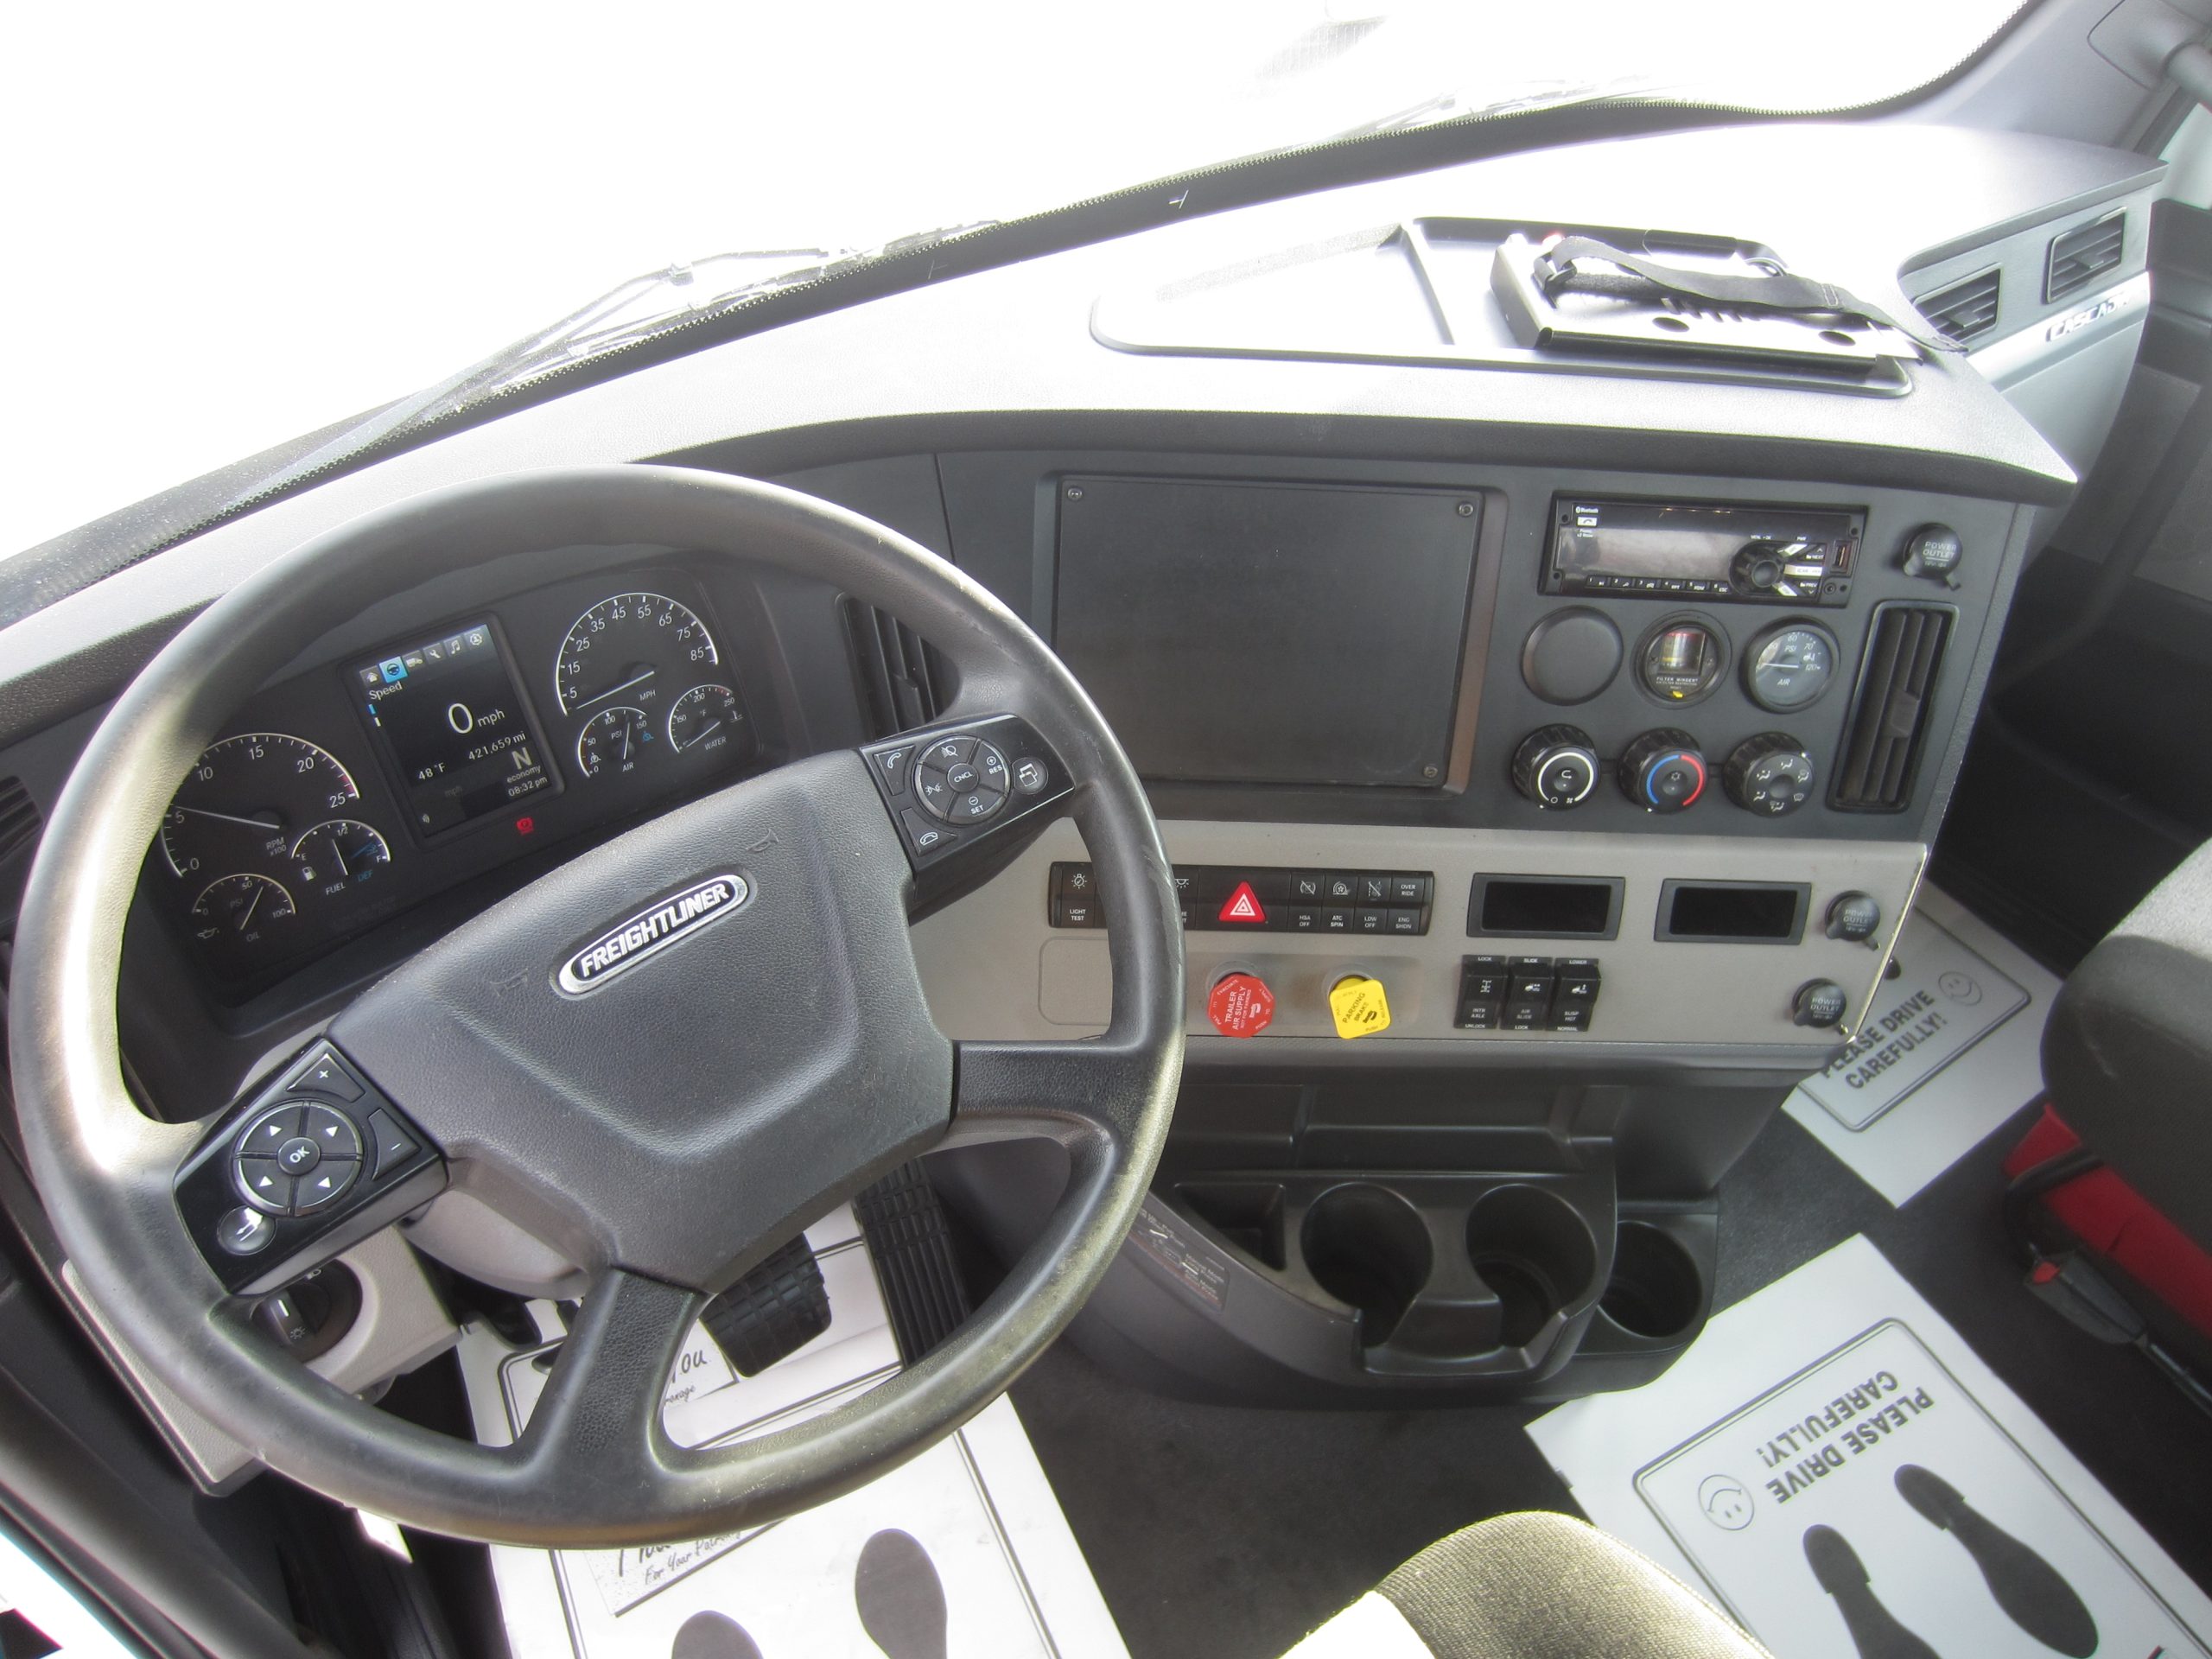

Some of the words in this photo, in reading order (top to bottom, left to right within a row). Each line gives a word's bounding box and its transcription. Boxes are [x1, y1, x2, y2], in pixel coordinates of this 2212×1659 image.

[1925, 542, 1956, 550] POWER
[1923, 550, 1955, 558] OUTLET
[612, 607, 626, 620] 45
[637, 605, 652, 620] 55
[590, 619, 606, 632] 35
[658, 613, 672, 627] 65
[677, 627, 691, 642] 75
[575, 637, 590, 652] 25
[690, 646, 704, 662] 85
[568, 661, 581, 675] 15
[368, 681, 403, 700] Speed
[569, 687, 578, 699] 5
[639, 690, 657, 702] MPH
[693, 693, 705, 703] 200
[723, 697, 734, 707] 250
[448, 702, 474, 734] 0
[477, 709, 505, 728] mph
[604, 715, 616, 725] 100
[677, 715, 687, 723] 150
[636, 720, 647, 730] 150
[513, 730, 526, 743] mi
[611, 731, 622, 740] PSI
[704, 736, 727, 751] WATER
[249, 745, 264, 760] 15
[512, 747, 533, 770] N
[297, 757, 315, 773] 20
[622, 762, 634, 772] AIR
[988, 765, 1003, 775] RES
[198, 766, 213, 781] 10
[507, 764, 542, 784] economy
[953, 772, 973, 783] CNCL
[508, 781, 535, 797] 08:32
[535, 776, 548, 788] pm
[329, 792, 346, 808] 25
[970, 804, 984, 815] SET
[175, 810, 185, 823] 5
[266, 837, 285, 850] RPM
[190, 858, 200, 870] 0
[376, 855, 381, 863] F
[357, 870, 373, 882] DEF
[242, 880, 252, 891] 50
[326, 882, 346, 895] FUEL
[230, 898, 244, 908] PSI
[272, 908, 286, 918] 100
[1843, 916, 1872, 925] OUTLET
[581, 883, 729, 978] FREIGHTLINER
[246, 932, 260, 943] OIL
[1224, 991, 1237, 1023] TRAILER
[1235, 986, 1247, 1016] SUPPLY
[1342, 992, 1365, 1023] PARKING
[1353, 1002, 1369, 1021] BRAKE
[1879, 990, 1935, 1033] DRIVE
[1232, 1016, 1241, 1030] AIR
[1845, 1012, 1948, 1089] CAREFULLY!
[289, 1145, 310, 1163] OK
[1756, 1370, 1897, 1468] CAREFULLY!
[1840, 1387, 1935, 1455] PLEASE
[1765, 1444, 1846, 1503] DRIVE
